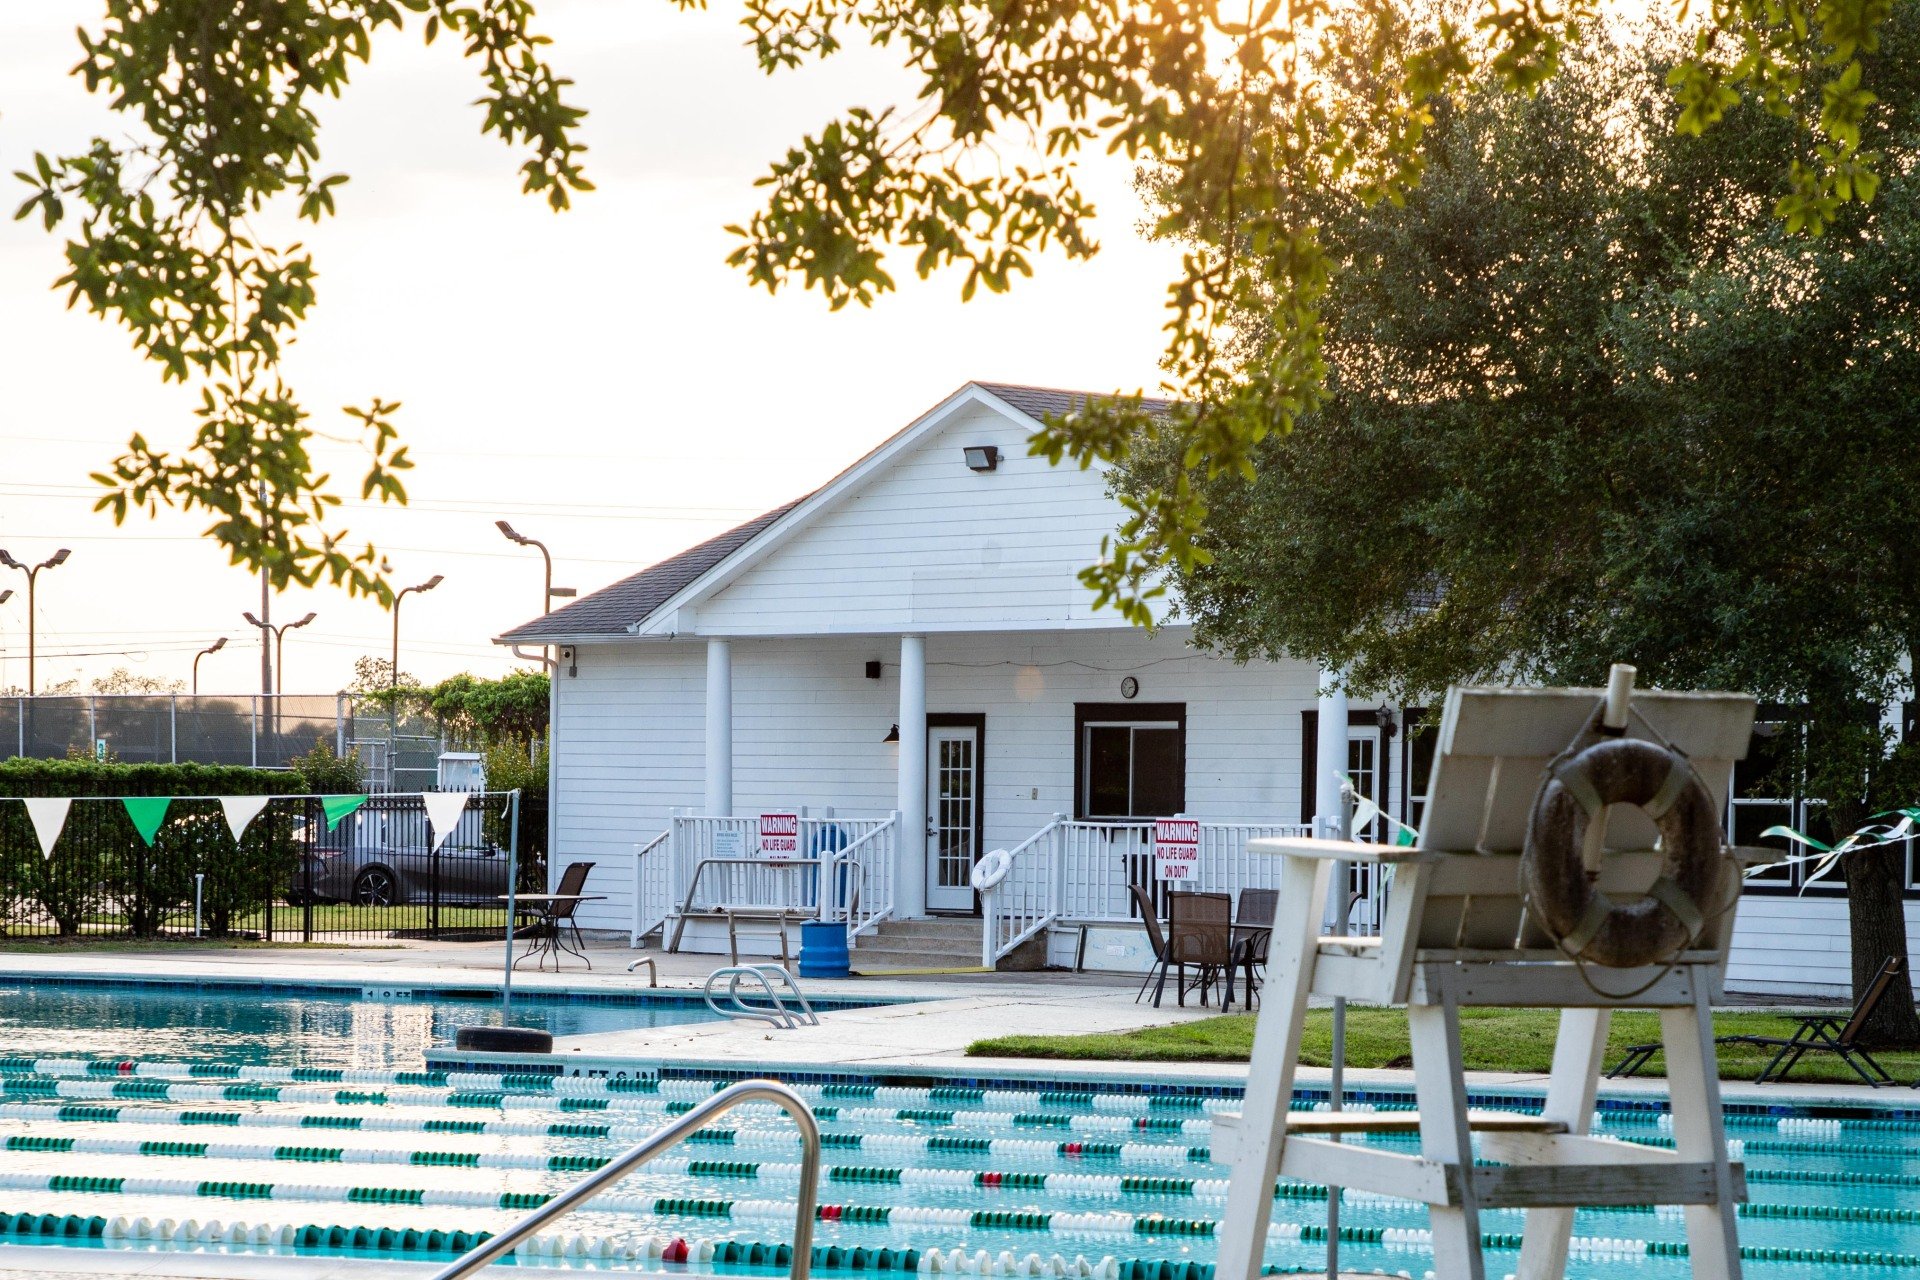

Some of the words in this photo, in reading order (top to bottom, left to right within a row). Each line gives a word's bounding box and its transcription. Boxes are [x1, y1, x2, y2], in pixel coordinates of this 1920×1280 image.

[761, 816, 796, 834] WARNING
[1156, 822, 1198, 842] WARNING
[762, 839, 769, 850] NO
[770, 839, 780, 850] LIFE
[781, 839, 797, 850] GUARD
[1157, 847, 1165, 859] NO
[1166, 847, 1177, 860] LIFE
[1179, 847, 1197, 860] GUARD
[1165, 865, 1173, 878] ON
[1174, 865, 1189, 878] DUTY
